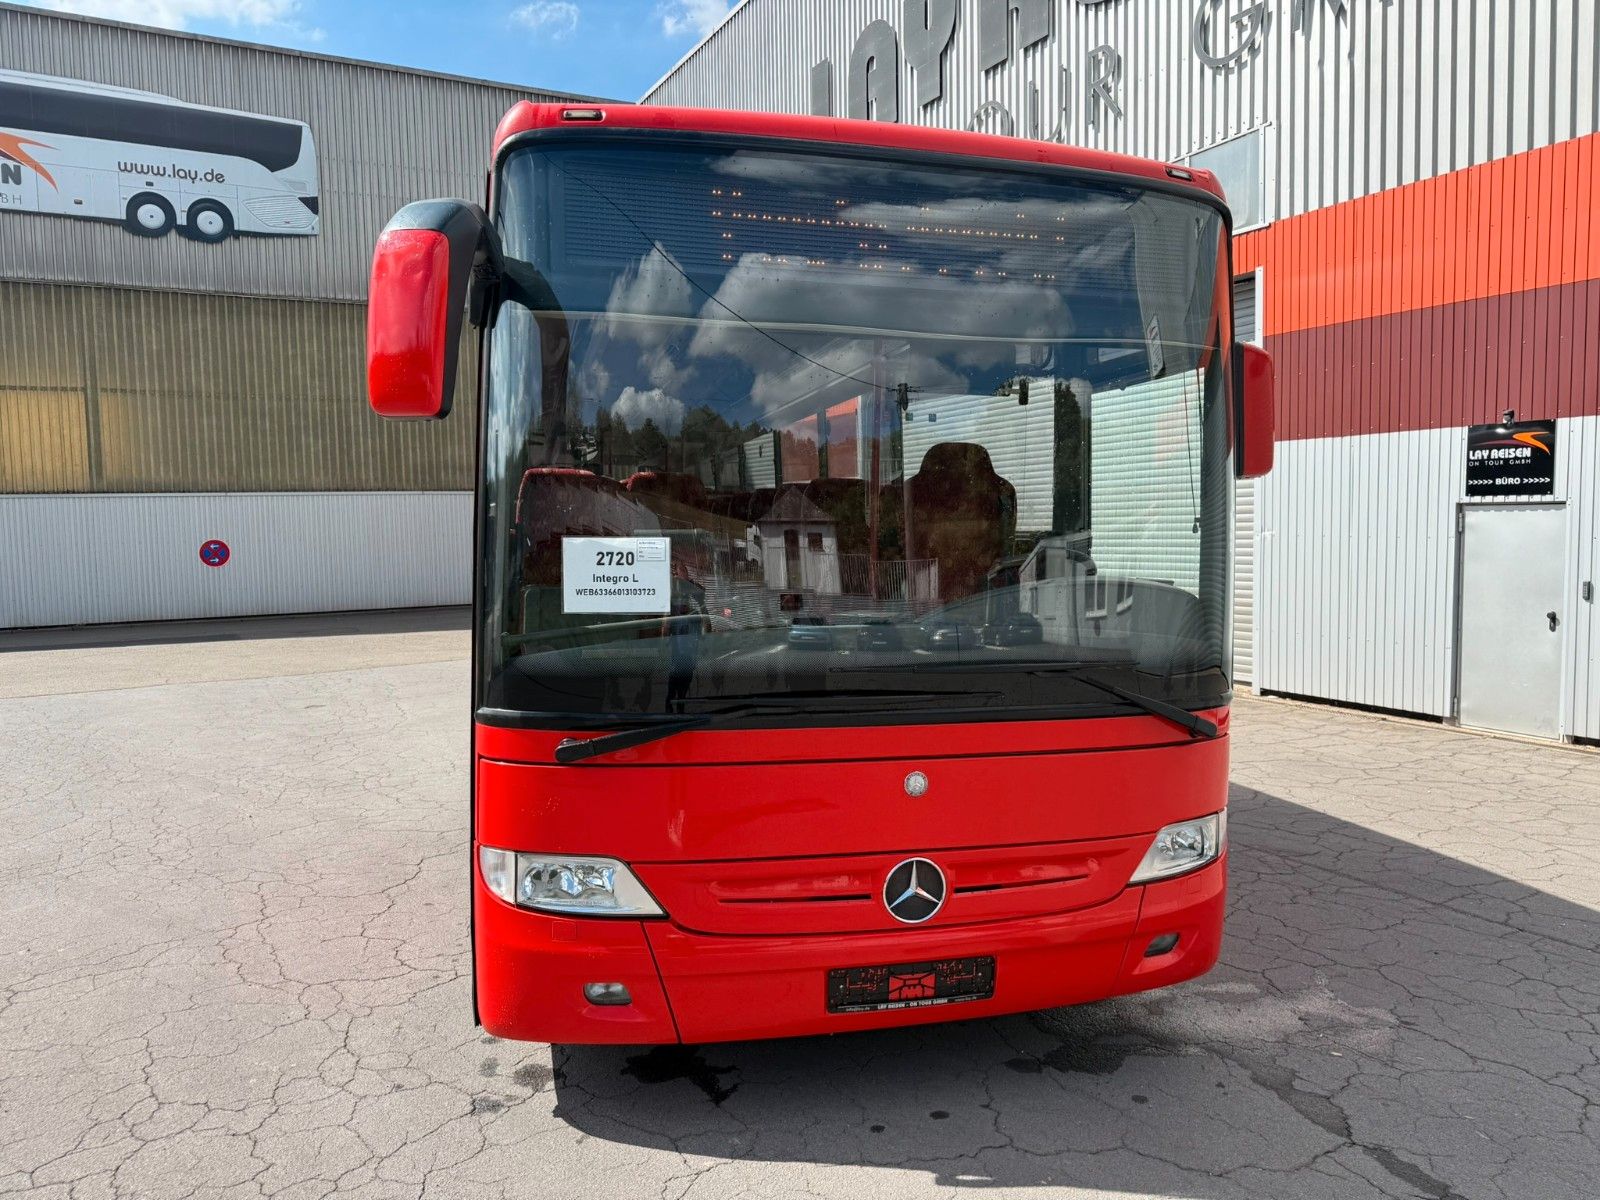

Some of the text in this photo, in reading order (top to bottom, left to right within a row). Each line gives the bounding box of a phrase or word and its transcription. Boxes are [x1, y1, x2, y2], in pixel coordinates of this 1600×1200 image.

[117, 161, 225, 184] www.lay.de
[1469, 447, 1531, 460] LAY REISEN
[1495, 476, 1520, 485] BÜRO
[596, 551, 635, 566] 2720
[592, 573, 639, 585] Integro L
[575, 588, 656, 596] WEB63366013103723
